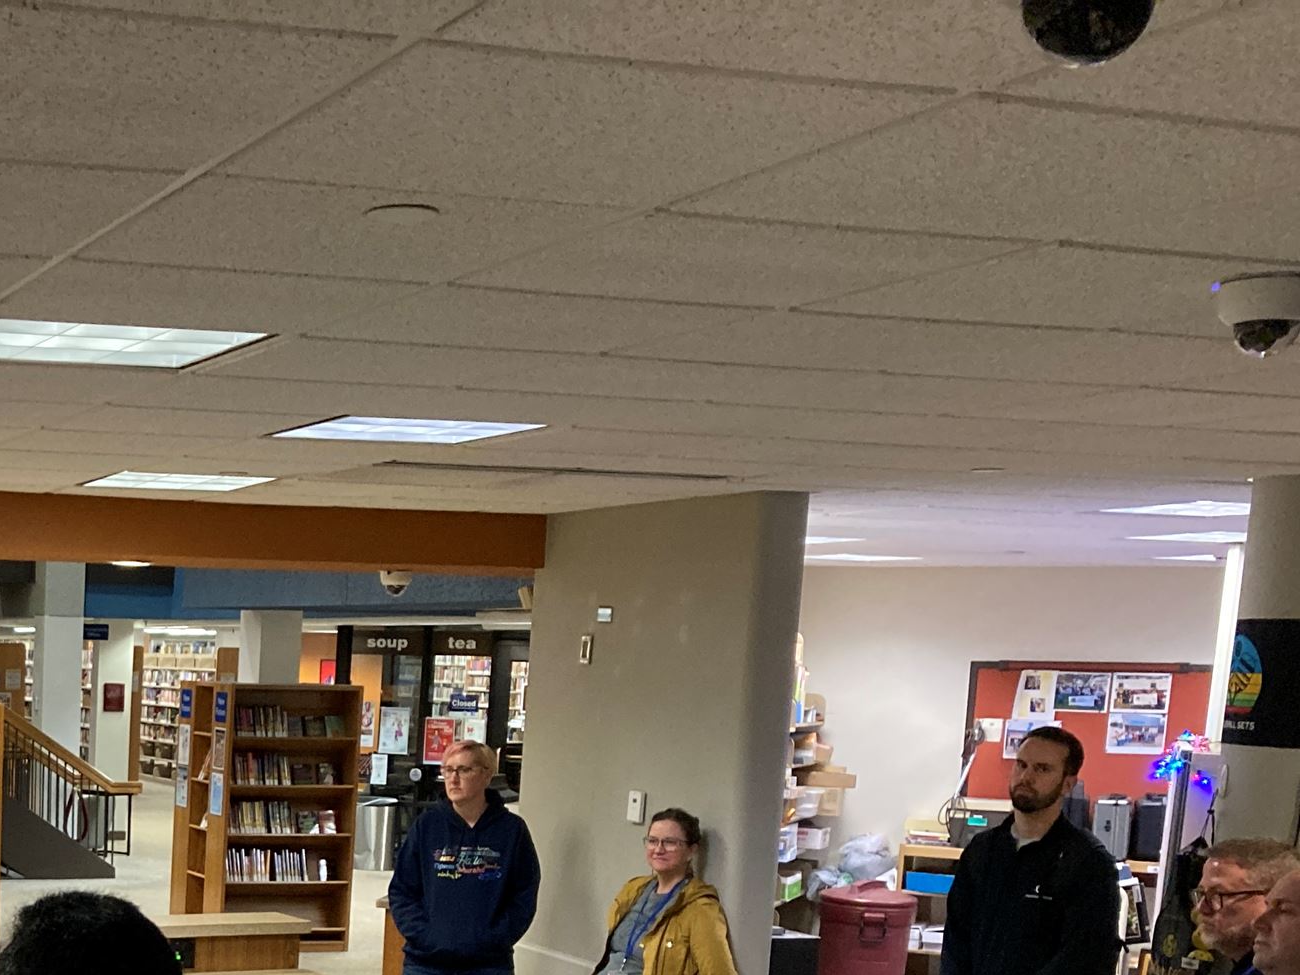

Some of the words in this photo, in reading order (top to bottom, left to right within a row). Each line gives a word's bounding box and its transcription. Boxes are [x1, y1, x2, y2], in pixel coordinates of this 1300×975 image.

[367, 637, 408, 651] soup
[448, 637, 477, 649] tea
[451, 699, 477, 708] Closed
